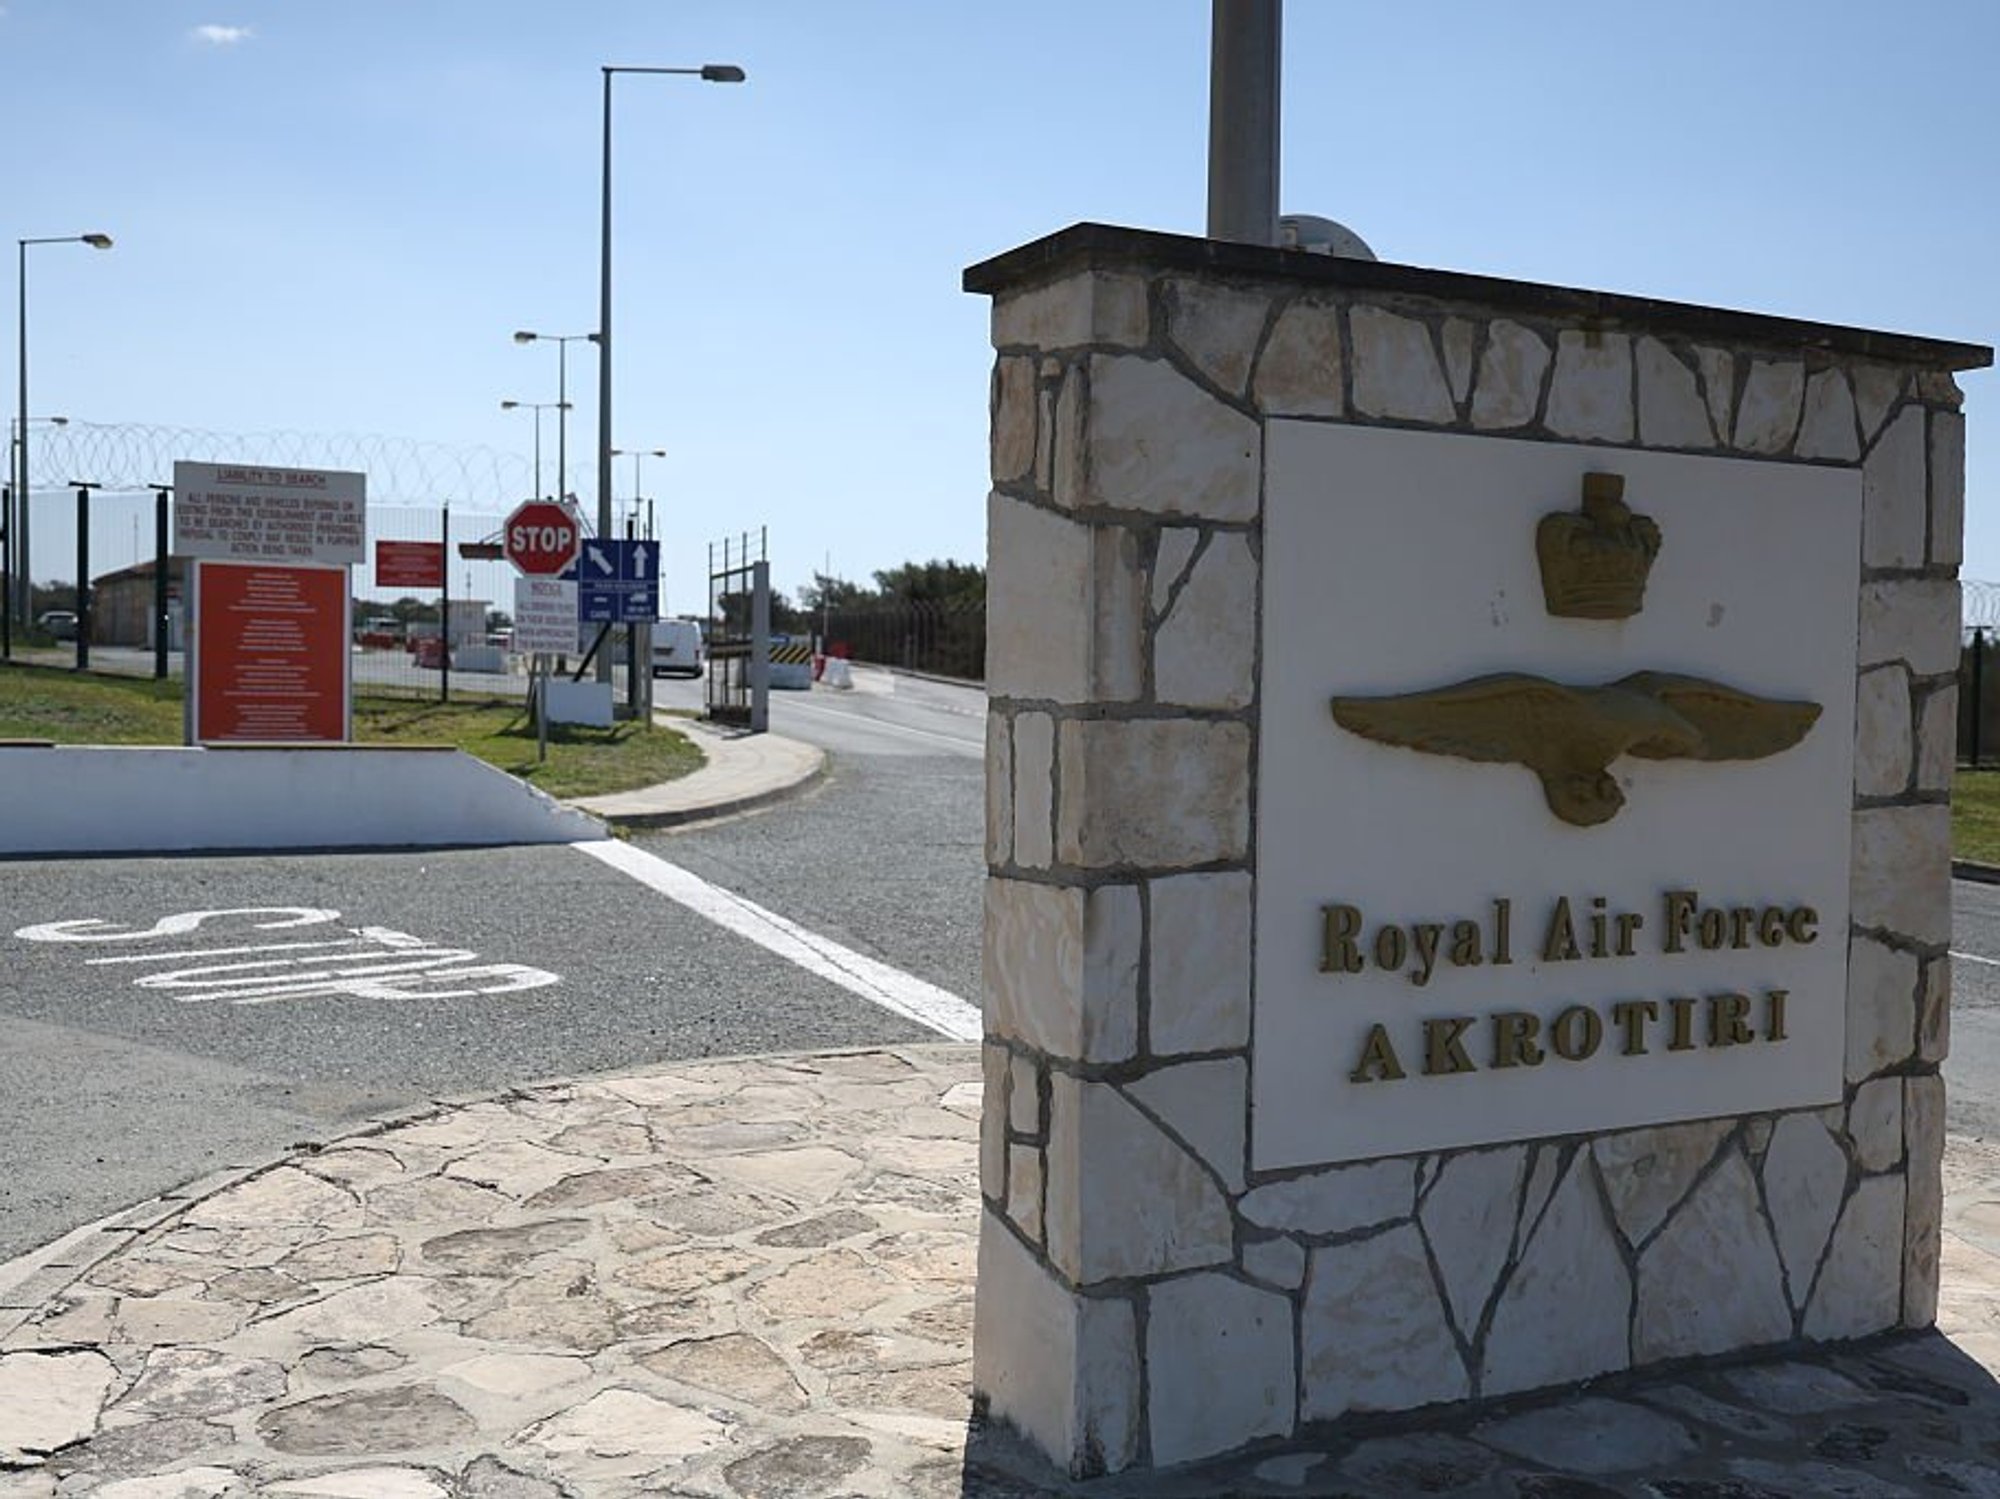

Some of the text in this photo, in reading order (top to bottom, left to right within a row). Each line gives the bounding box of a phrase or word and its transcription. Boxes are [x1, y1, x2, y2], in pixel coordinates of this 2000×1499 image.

[512, 525, 572, 552] STOP
[1319, 890, 1819, 987] Royal Air Force
[1349, 990, 1790, 1084] AKROTIRI
